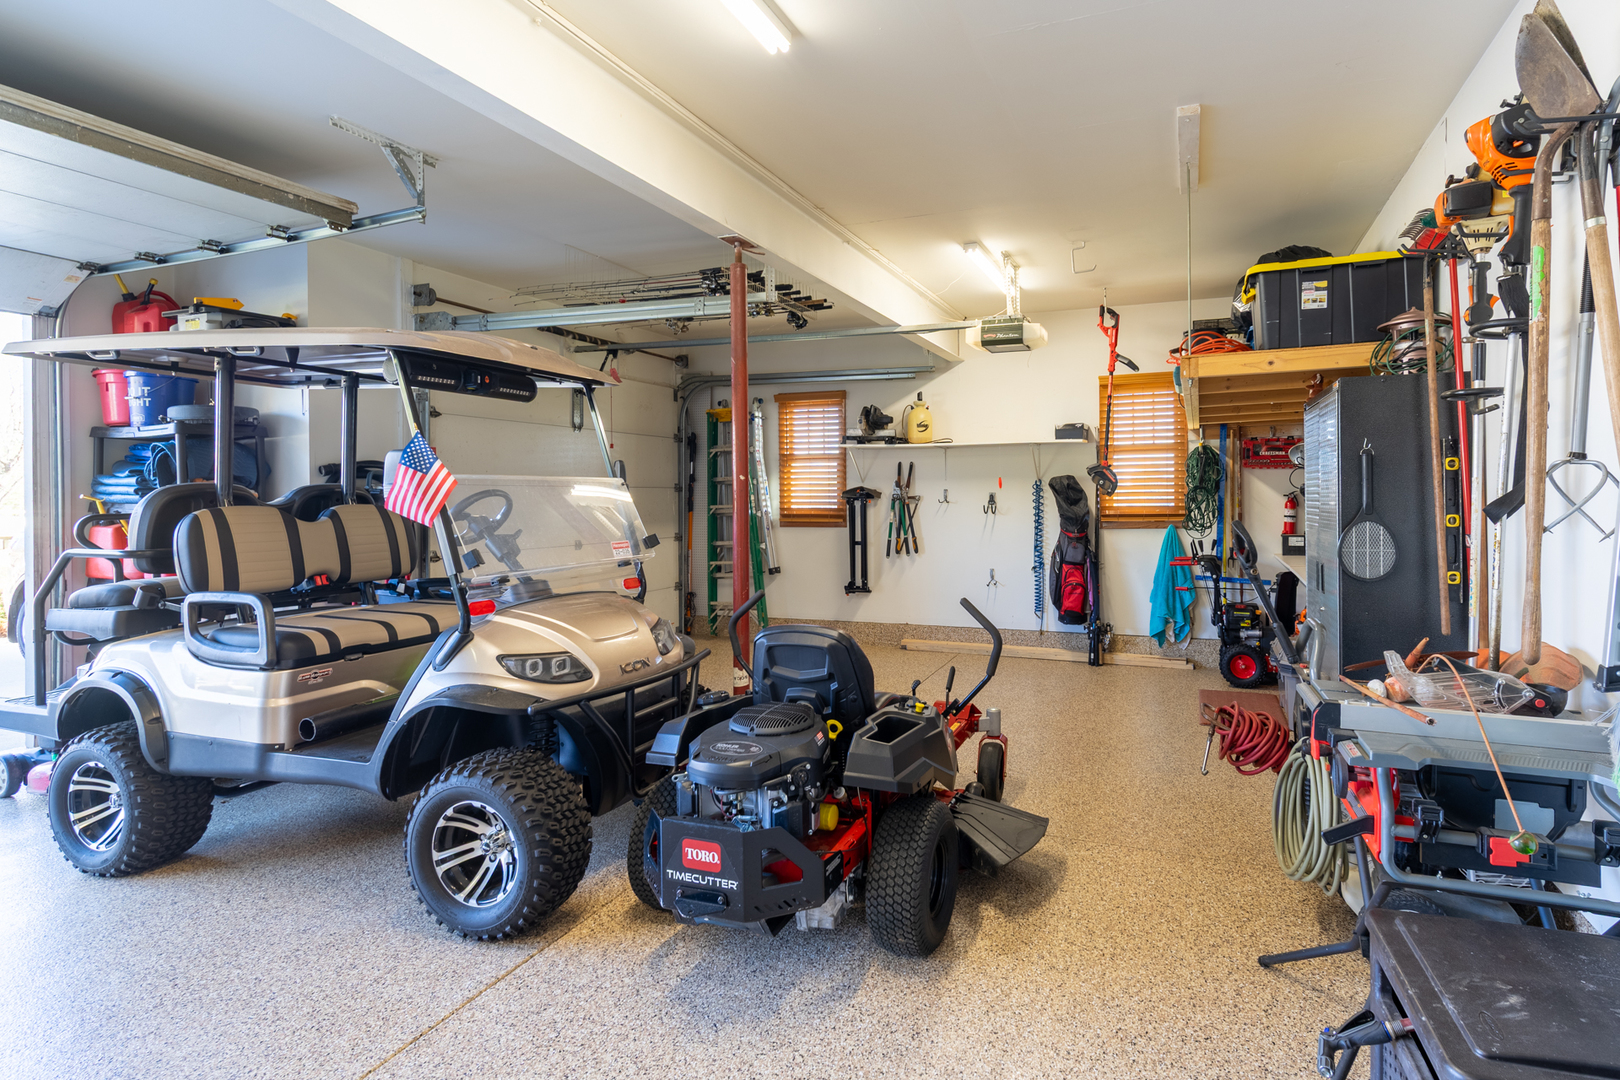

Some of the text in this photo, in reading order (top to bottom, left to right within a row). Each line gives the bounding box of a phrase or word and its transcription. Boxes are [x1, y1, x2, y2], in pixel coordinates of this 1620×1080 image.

[138, 387, 151, 397] IT
[619, 656, 651, 676] ICON
[685, 847, 719, 864] TORO
[666, 869, 739, 891] TIMECUTTER
